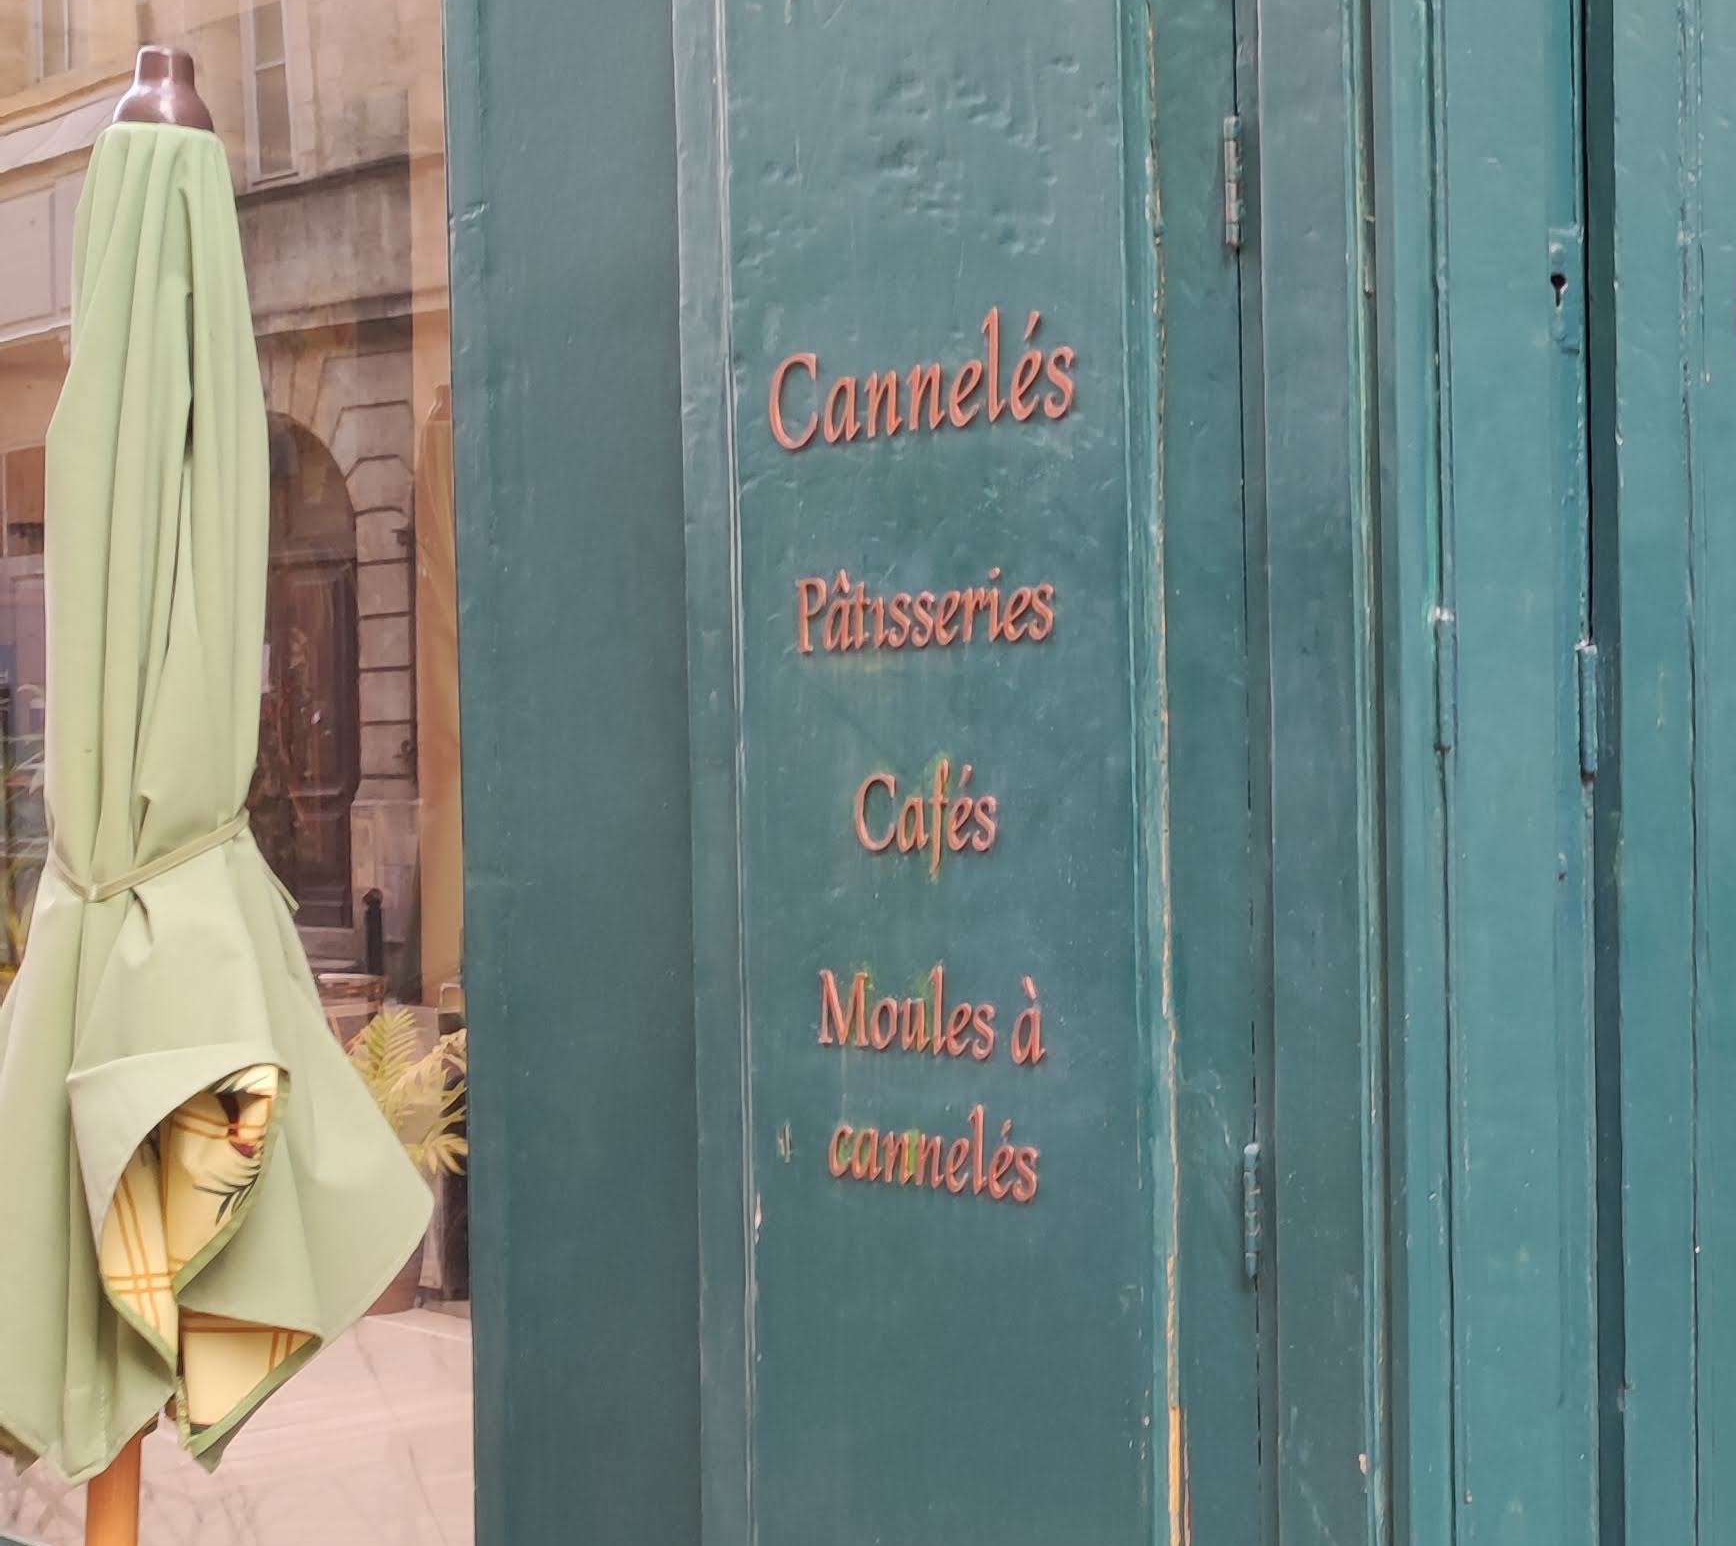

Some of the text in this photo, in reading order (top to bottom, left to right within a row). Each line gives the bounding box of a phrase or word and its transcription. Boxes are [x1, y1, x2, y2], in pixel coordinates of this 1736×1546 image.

[769, 306, 1075, 452] Cannelés
[795, 567, 1055, 653] Pâtisseries
[855, 758, 997, 880] Cafés
[818, 965, 1046, 1065] Moules à
[828, 1104, 1040, 1202] cannelés
